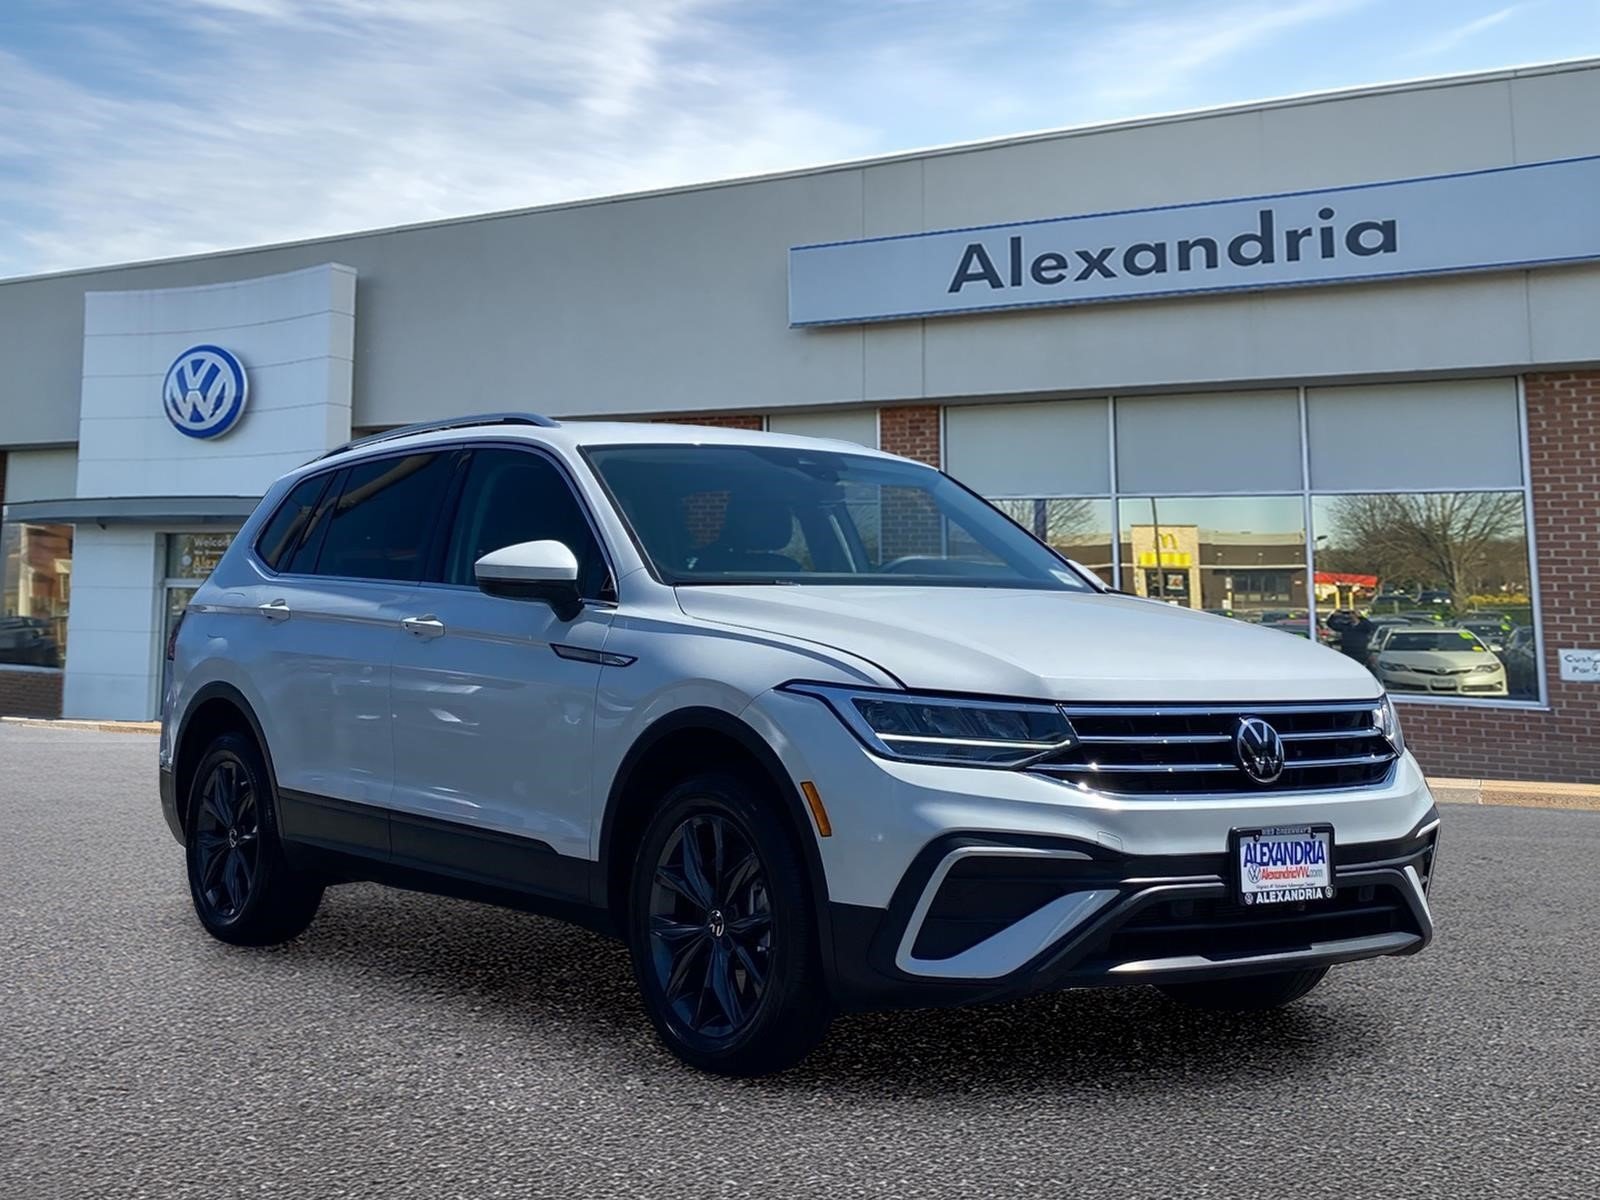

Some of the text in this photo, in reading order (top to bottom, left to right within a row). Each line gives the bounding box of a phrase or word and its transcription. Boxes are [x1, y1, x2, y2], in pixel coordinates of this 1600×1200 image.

[947, 208, 1399, 294] Alexandria
[1243, 840, 1325, 867] ALEXANDRIA
[1256, 888, 1323, 904] ALEXANDRIA
